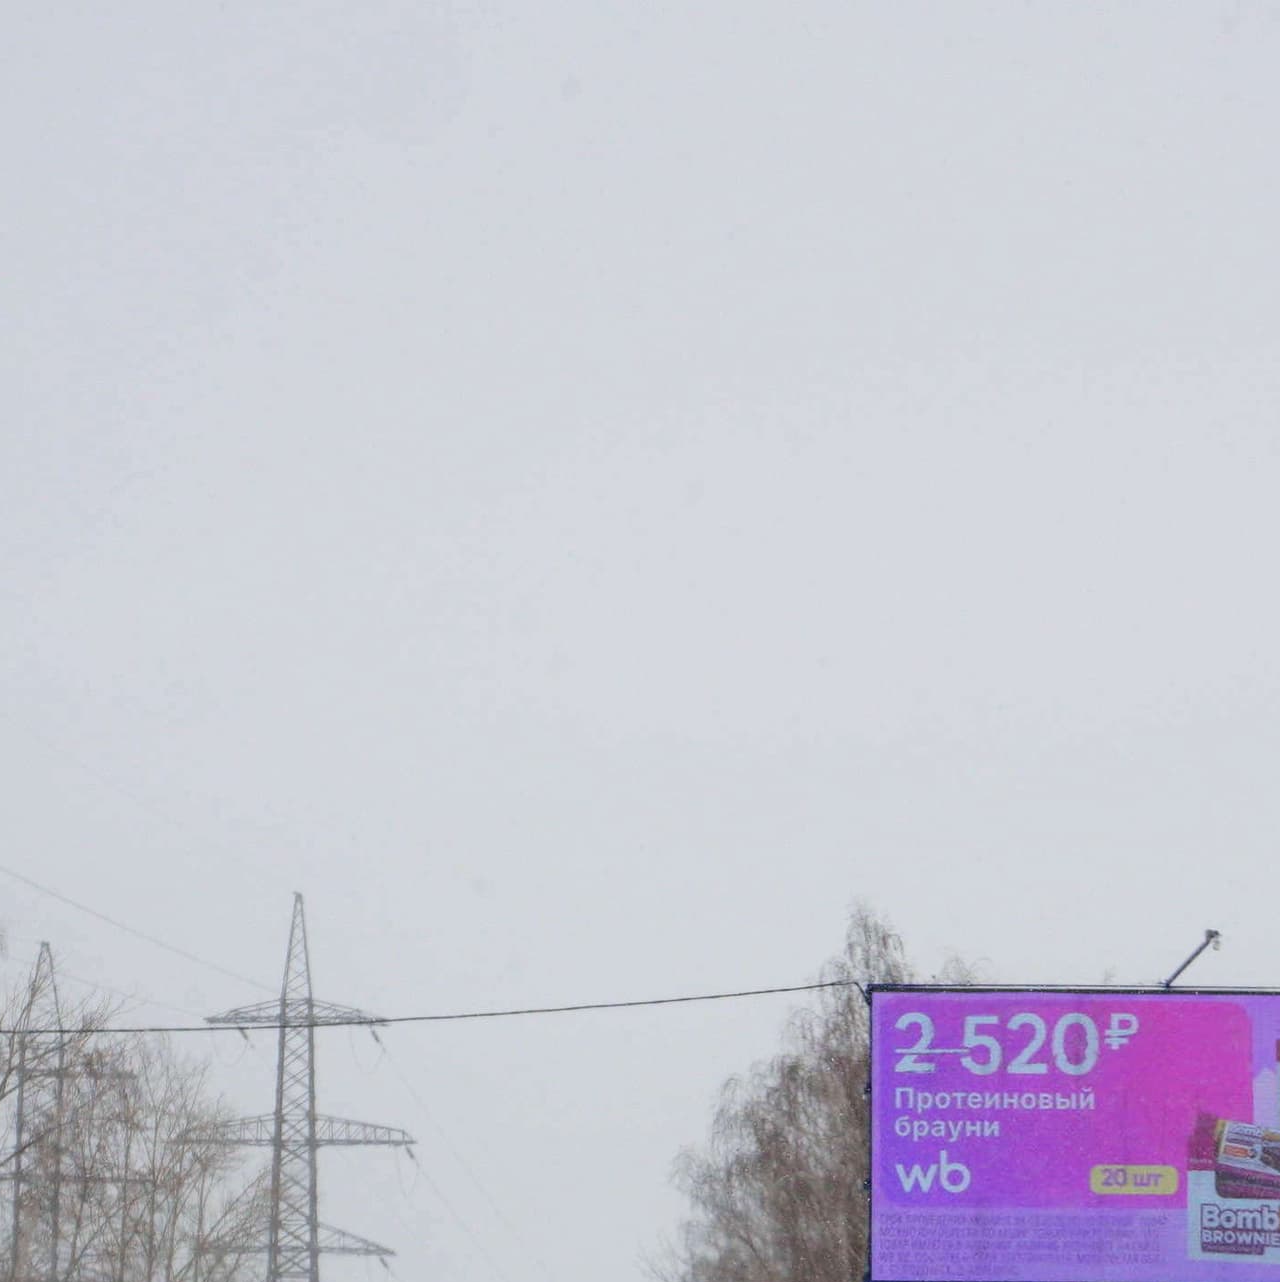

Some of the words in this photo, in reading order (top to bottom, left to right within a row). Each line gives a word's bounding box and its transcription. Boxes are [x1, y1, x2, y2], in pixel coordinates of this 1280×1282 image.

[894, 1012, 936, 1073] 2
[894, 1086, 1096, 1113] Протеиновый
[894, 1115, 1000, 1142] брауни
[895, 1149, 971, 1193] wb
[1101, 1168, 1128, 1188] 20
[1133, 1171, 1163, 1188] шт
[1202, 1230, 1280, 1247] BROWNIE
